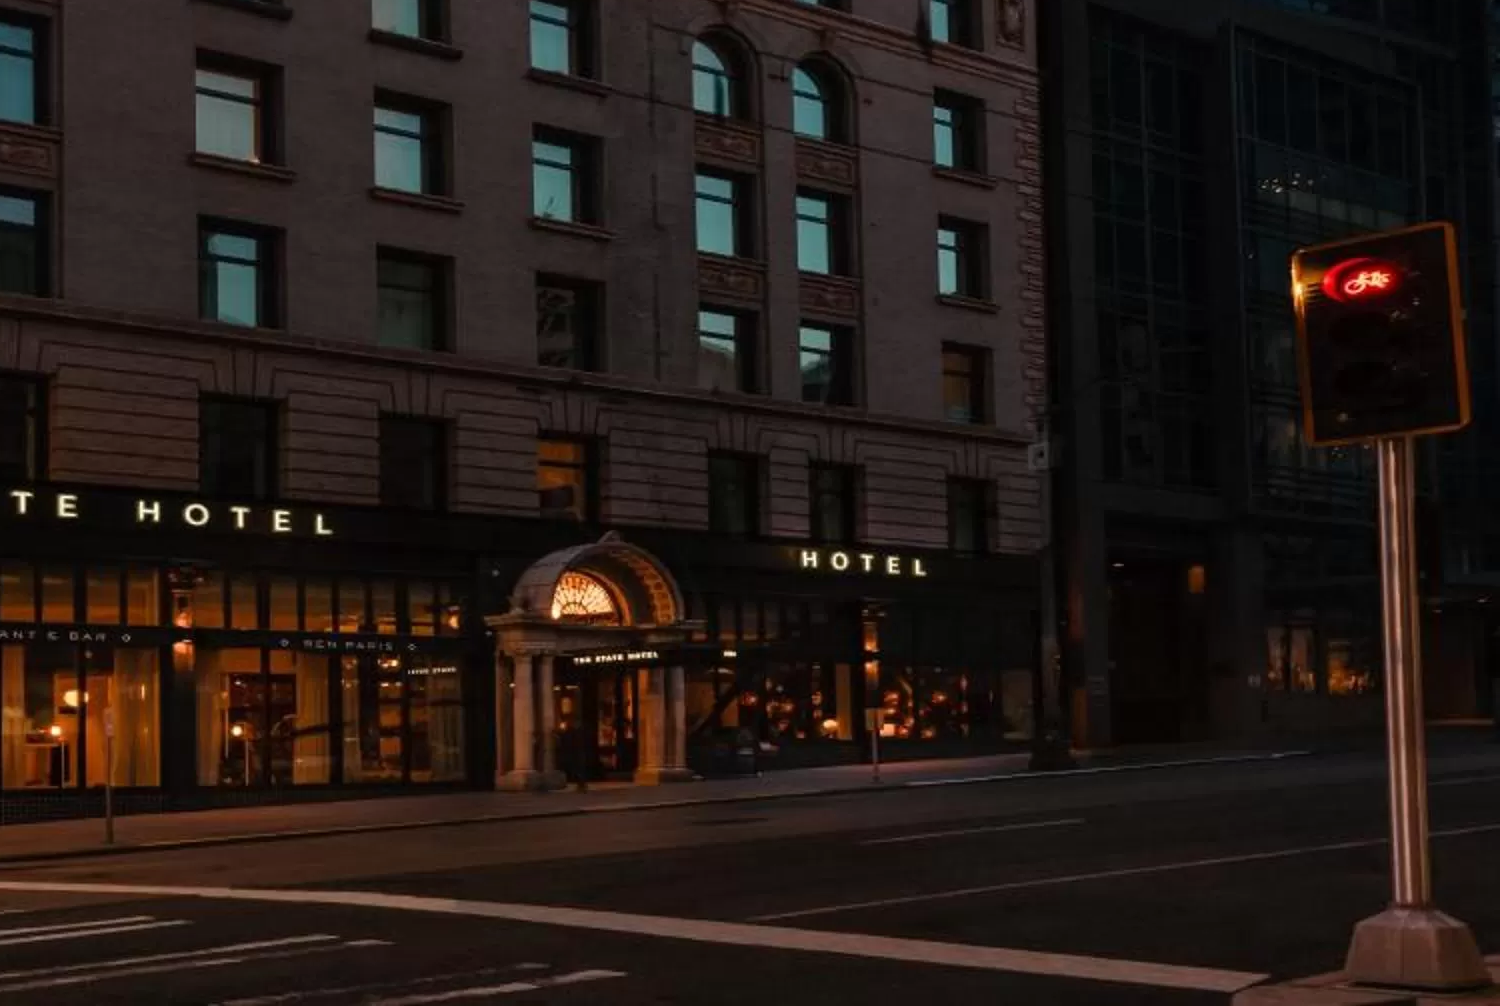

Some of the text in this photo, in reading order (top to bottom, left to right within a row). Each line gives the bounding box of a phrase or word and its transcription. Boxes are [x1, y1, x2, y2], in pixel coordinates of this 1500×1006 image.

[136, 499, 334, 536] HOTEL
[801, 549, 928, 577] HOTEL
[69, 631, 107, 642] BAR
[302, 638, 393, 651] BEN PARIS
